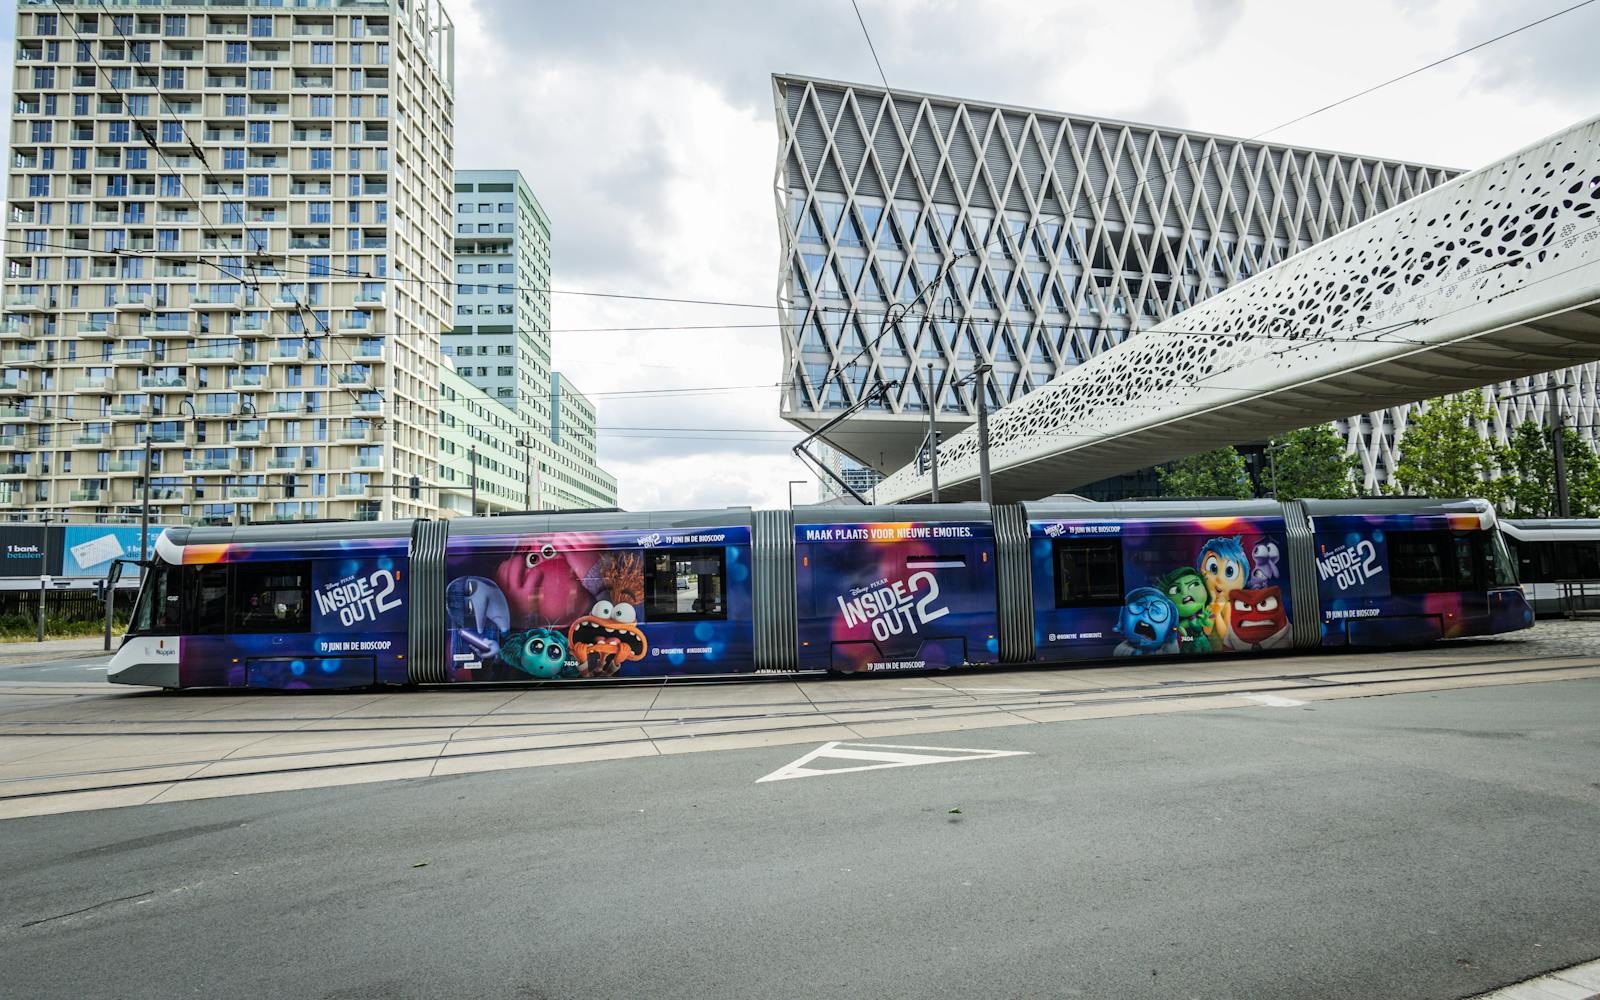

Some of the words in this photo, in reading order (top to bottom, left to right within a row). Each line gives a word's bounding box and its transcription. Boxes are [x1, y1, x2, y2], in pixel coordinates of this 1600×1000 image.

[807, 530, 833, 540] MAAK
[836, 529, 869, 539] PLAATS
[870, 529, 894, 539] VOOR
[897, 528, 930, 538] NIEUWE
[934, 527, 973, 537] EMOTIES.
[1057, 523, 1066, 534] 2
[653, 534, 661, 545] 2
[672, 536, 683, 544] JUNI
[1316, 547, 1360, 580] INSIDE
[1337, 562, 1364, 590] OUT
[1357, 540, 1383, 578] 2
[340, 576, 355, 584] PIXAR
[850, 587, 869, 596] Disney
[870, 578, 888, 588] PIXAR
[315, 577, 374, 616] INSIDE
[340, 595, 376, 626] OUT
[370, 569, 402, 613] 2
[837, 580, 913, 628] INSIDE
[872, 602, 918, 641] OUT
[908, 571, 950, 624] 2
[1332, 611, 1342, 620] JUNI
[321, 642, 328, 651] 19
[328, 642, 342, 652] JUNI
[343, 642, 349, 650] IN
[351, 642, 359, 650] DE
[361, 641, 391, 650] BIOSCOOP
[873, 662, 884, 671] JUNI
[886, 662, 891, 670] IN
[900, 661, 925, 669] BIOSCOOP
